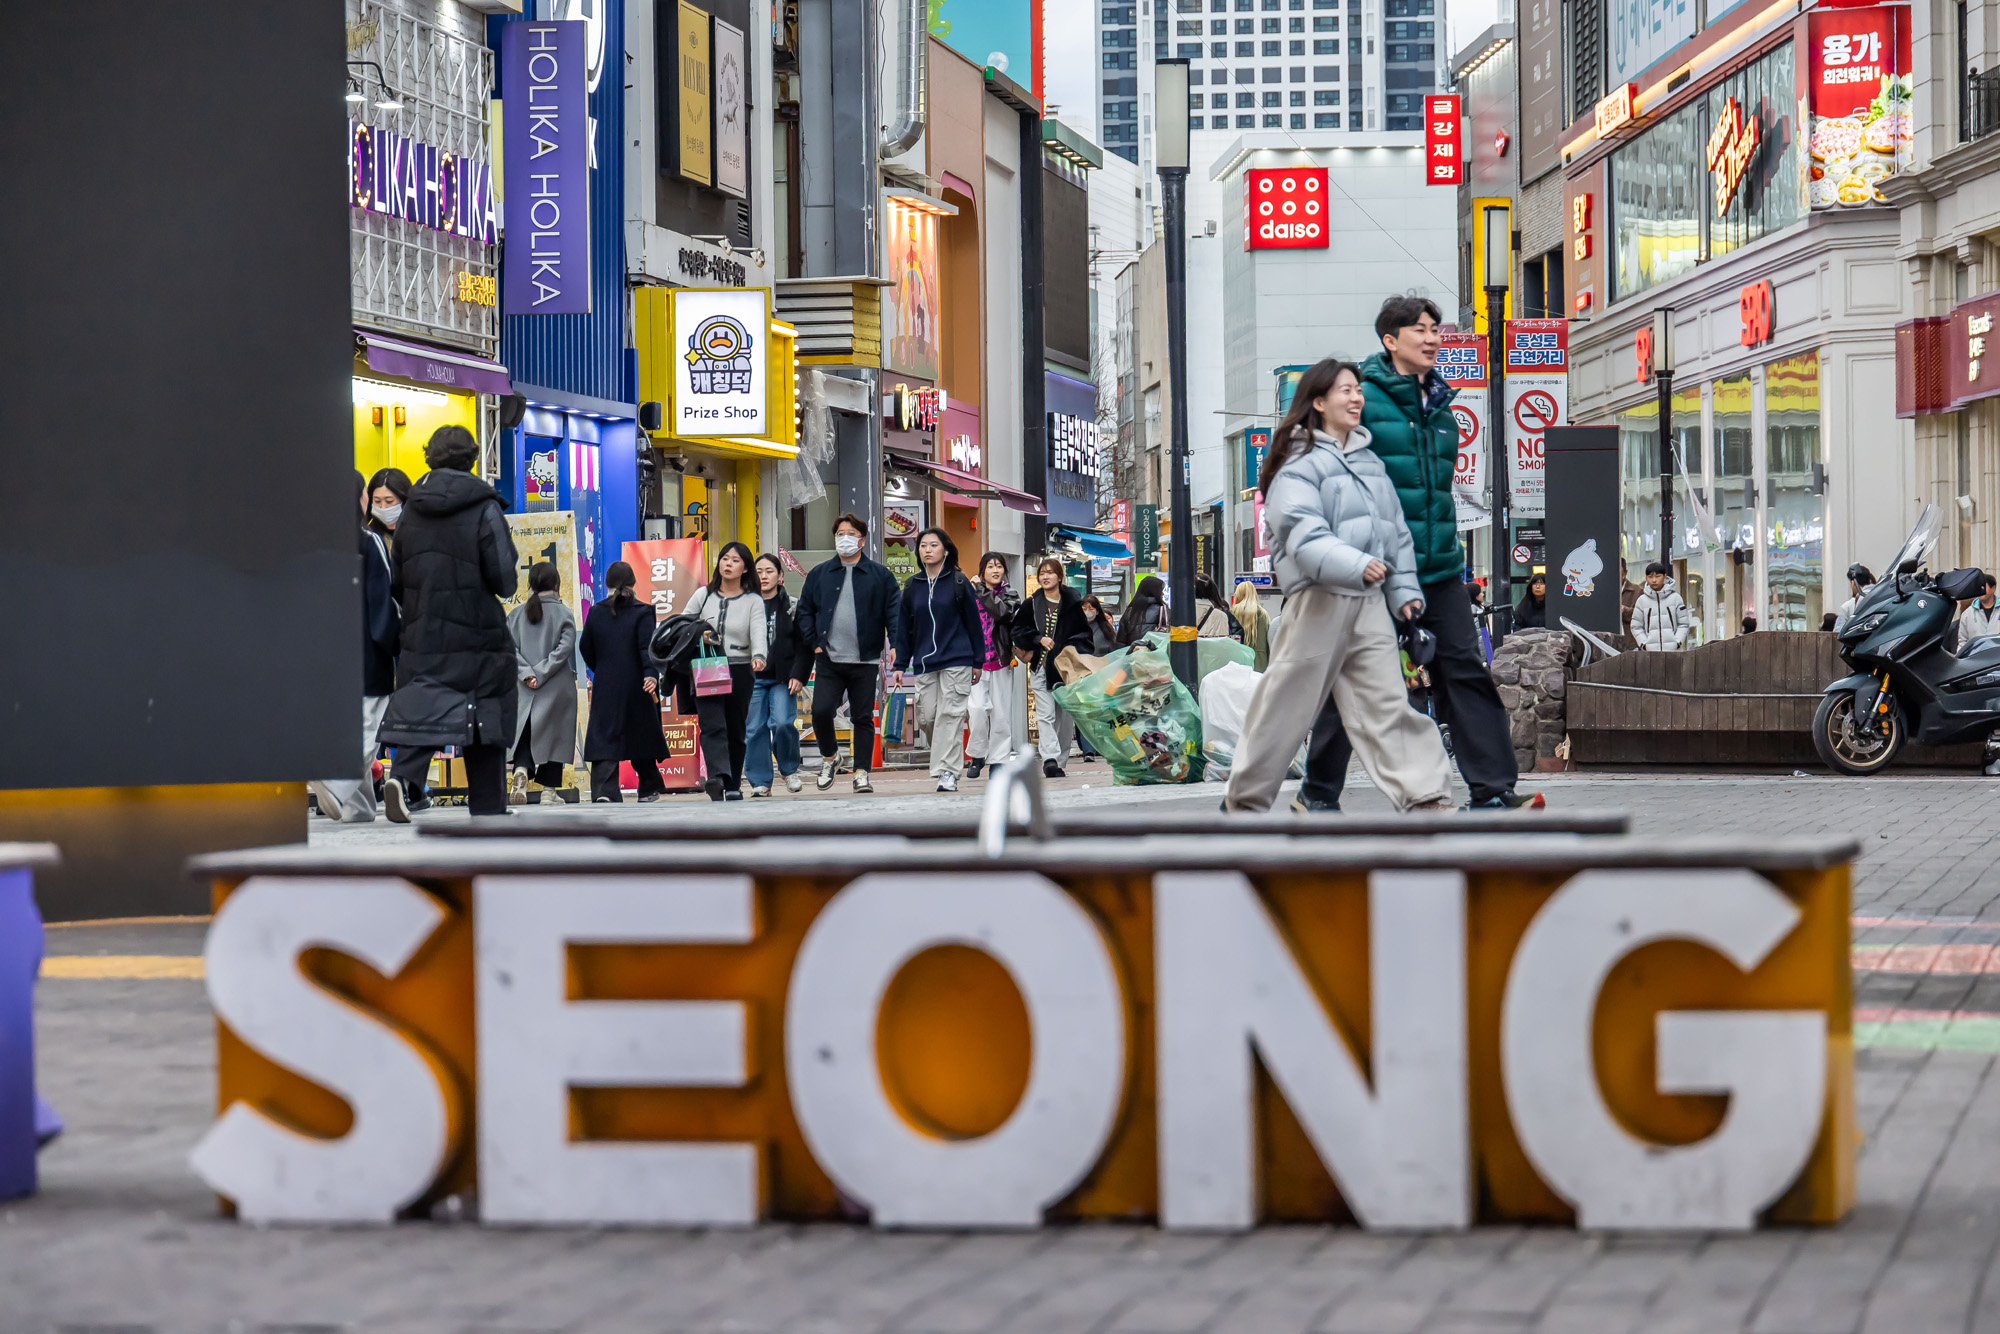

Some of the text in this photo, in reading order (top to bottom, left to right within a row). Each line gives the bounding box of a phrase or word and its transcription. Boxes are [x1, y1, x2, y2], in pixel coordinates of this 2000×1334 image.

[1823, 31, 1882, 65] 용가
[1823, 66, 1873, 84] 회전훠궈
[1433, 100, 1455, 178] 금강제화
[529, 28, 560, 307] HOLIKA HOLIKA
[424, 142, 499, 244] HOLIKA
[1260, 219, 1320, 239] daiso
[1740, 279, 1770, 347] SPAO
[1516, 333, 1558, 348] 동성로
[1435, 348, 1478, 363] 동성로
[1508, 349, 1564, 365] 금연거리
[692, 371, 751, 393] 캐칭덕
[684, 406, 758, 420] Prize Shop
[1454, 453, 1477, 473] O!
[1454, 475, 1475, 485] OKE
[554, 526, 567, 534] 비밀
[1143, 508, 1151, 559] CROCODILE
[665, 730, 688, 739] 가입시
[678, 740, 693, 749] 할인
[189, 871, 1829, 1231] SEONG
